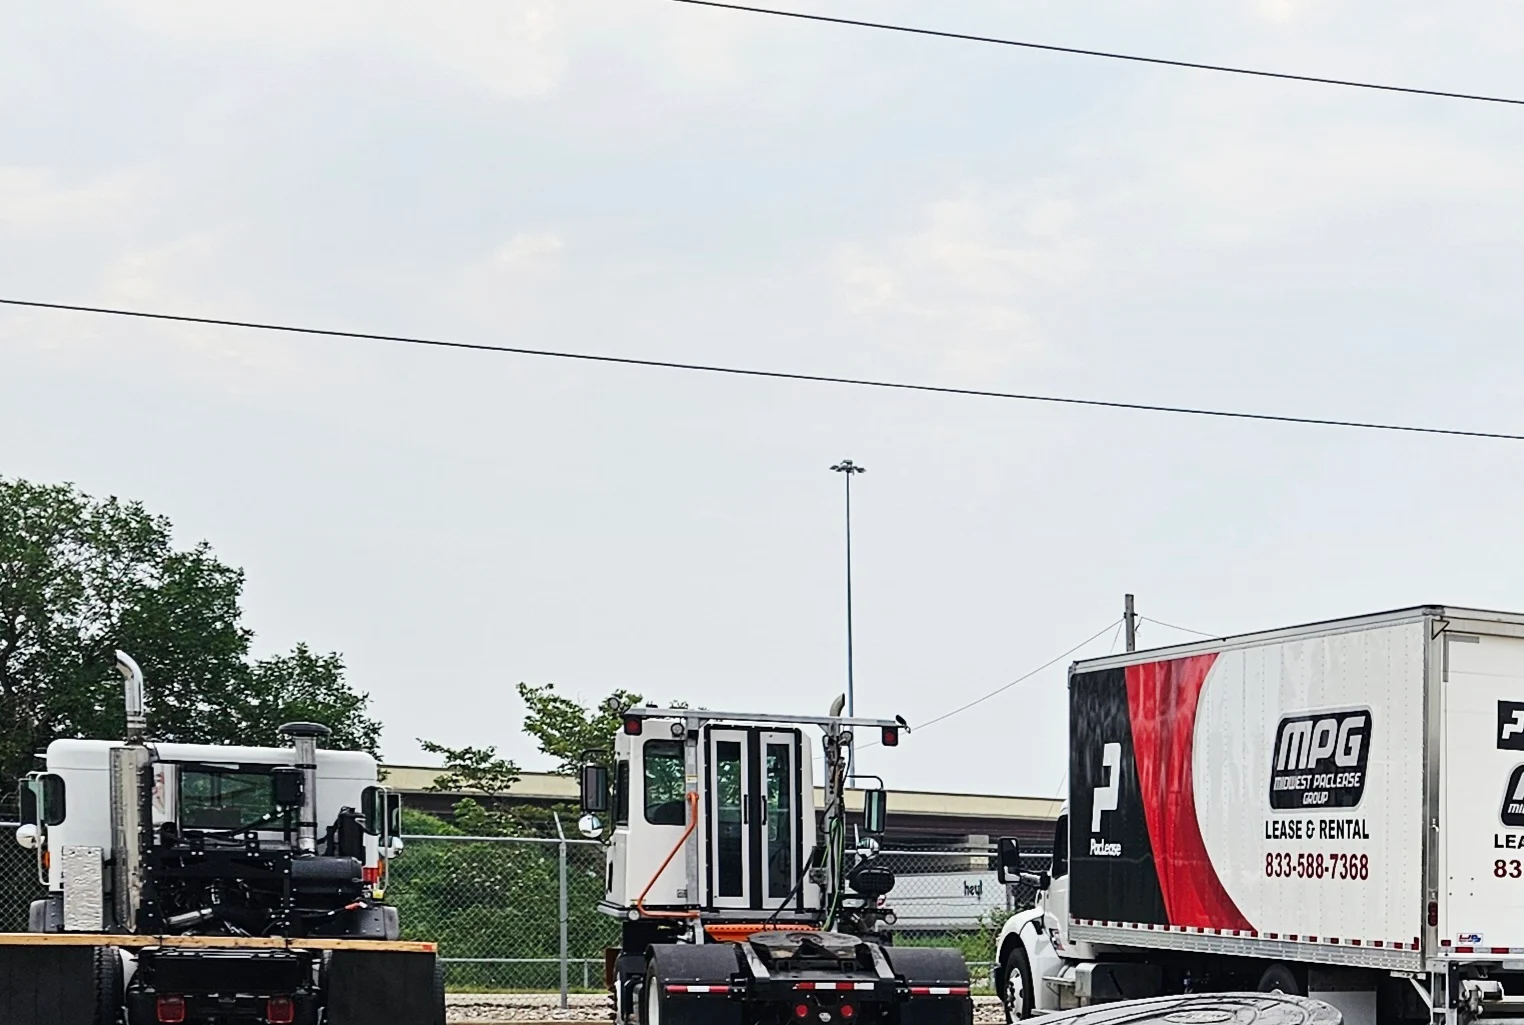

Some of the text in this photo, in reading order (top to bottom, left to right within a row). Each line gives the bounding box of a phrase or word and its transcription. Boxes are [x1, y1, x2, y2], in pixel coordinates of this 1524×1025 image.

[1276, 716, 1366, 771] MPG
[1273, 772, 1362, 791] MIDWEST PACLEASE
[1302, 791, 1329, 805] GROUP
[1265, 819, 1370, 840] LEASE & RENTAL
[1089, 838, 1122, 857] PacLease
[1265, 852, 1369, 881] 833-588-7368
